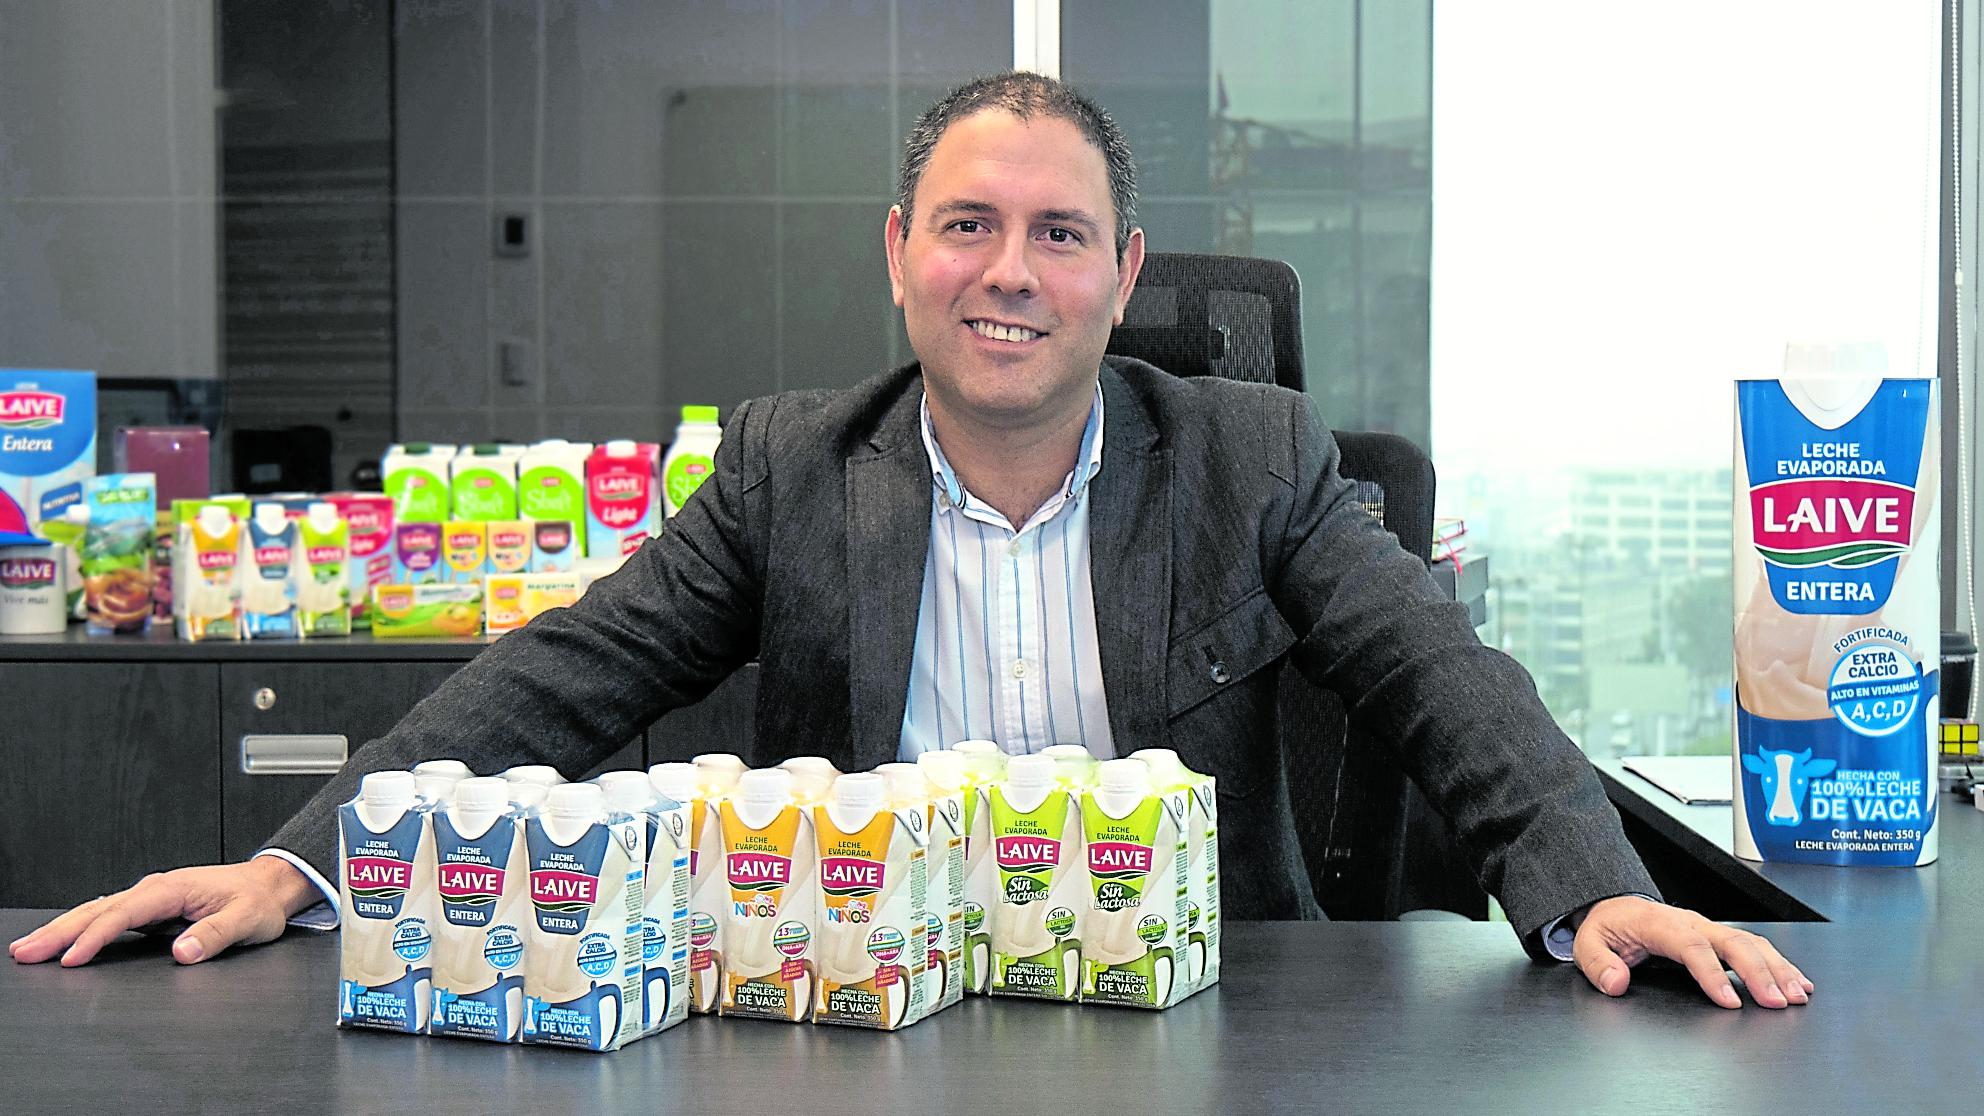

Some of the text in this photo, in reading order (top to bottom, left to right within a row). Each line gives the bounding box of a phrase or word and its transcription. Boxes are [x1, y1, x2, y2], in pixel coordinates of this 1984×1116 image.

[0, 398, 57, 416] LAIVE
[3, 434, 53, 451] Entera
[1802, 443, 1860, 458] LECHE
[1777, 460, 1886, 475] EVAPORADA
[600, 478, 639, 491] LAIVE
[602, 507, 639, 524] Light
[1763, 497, 1899, 533] LAIVE
[2, 563, 52, 578] LAIVE
[1786, 581, 1875, 601] ENTERA
[1834, 628, 1908, 653] FORTIFICADA
[1853, 652, 1897, 665] EXTRA
[1848, 664, 1899, 678] CALCIO
[1831, 680, 1919, 701] ALTO EN VITAMINAS
[1837, 771, 1900, 781] HECHA CON
[1811, 798, 1920, 820] DE VACA
[1004, 827, 1048, 835] EVAPORADA
[1107, 826, 1130, 834] LECHE
[1832, 829, 1922, 842] Cont. Neto: 350 g
[745, 836, 768, 844] LECHE
[1096, 833, 1140, 842] EVAPORADA
[365, 840, 390, 849] LECHE
[457, 846, 481, 855] LECHE
[735, 843, 778, 852] EVAPORADA
[999, 842, 1054, 860] LAIVE
[1795, 841, 1914, 851] LECHE EVAPORADA ENTERA
[355, 847, 399, 857] EVAPORADA
[446, 853, 491, 864] EVAPORADA
[550, 853, 575, 862] LECHE
[828, 848, 872, 857] EVAPORADA
[1091, 848, 1146, 867] LAIVE
[540, 860, 585, 871] EVAPORADA
[730, 859, 784, 878] LAIVE
[350, 864, 405, 884] LAIVE
[441, 870, 497, 890] LAIVE
[823, 864, 878, 883] LAIVE
[534, 877, 590, 898] LAIVE
[1009, 877, 1031, 892] Sin
[1100, 883, 1124, 899] Sin
[1003, 889, 1048, 903] Lactosa
[358, 902, 394, 914] ENTERA
[735, 902, 777, 917] NIÑOS
[1094, 896, 1140, 910] Lactosa
[450, 909, 485, 921] ENTERA
[828, 908, 871, 923] NIÑOS
[1052, 910, 1066, 919] SIN
[542, 917, 579, 929] ENTERA
[1143, 918, 1158, 927] SIN
[778, 927, 790, 936] 13
[1141, 925, 1164, 934] LACTOSA
[492, 939, 514, 947] CALCIO
[872, 933, 883, 943] 13
[586, 947, 607, 955] CALCIO
[1008, 975, 1057, 986] DE VACA
[1099, 982, 1148, 995] DE VACA
[738, 994, 786, 1007] DE VACA
[357, 1004, 407, 1019] DE VACA
[831, 1001, 881, 1015] DE VACA
[449, 1013, 498, 1027] DE VACA
[541, 1021, 591, 1036] DE VACA
